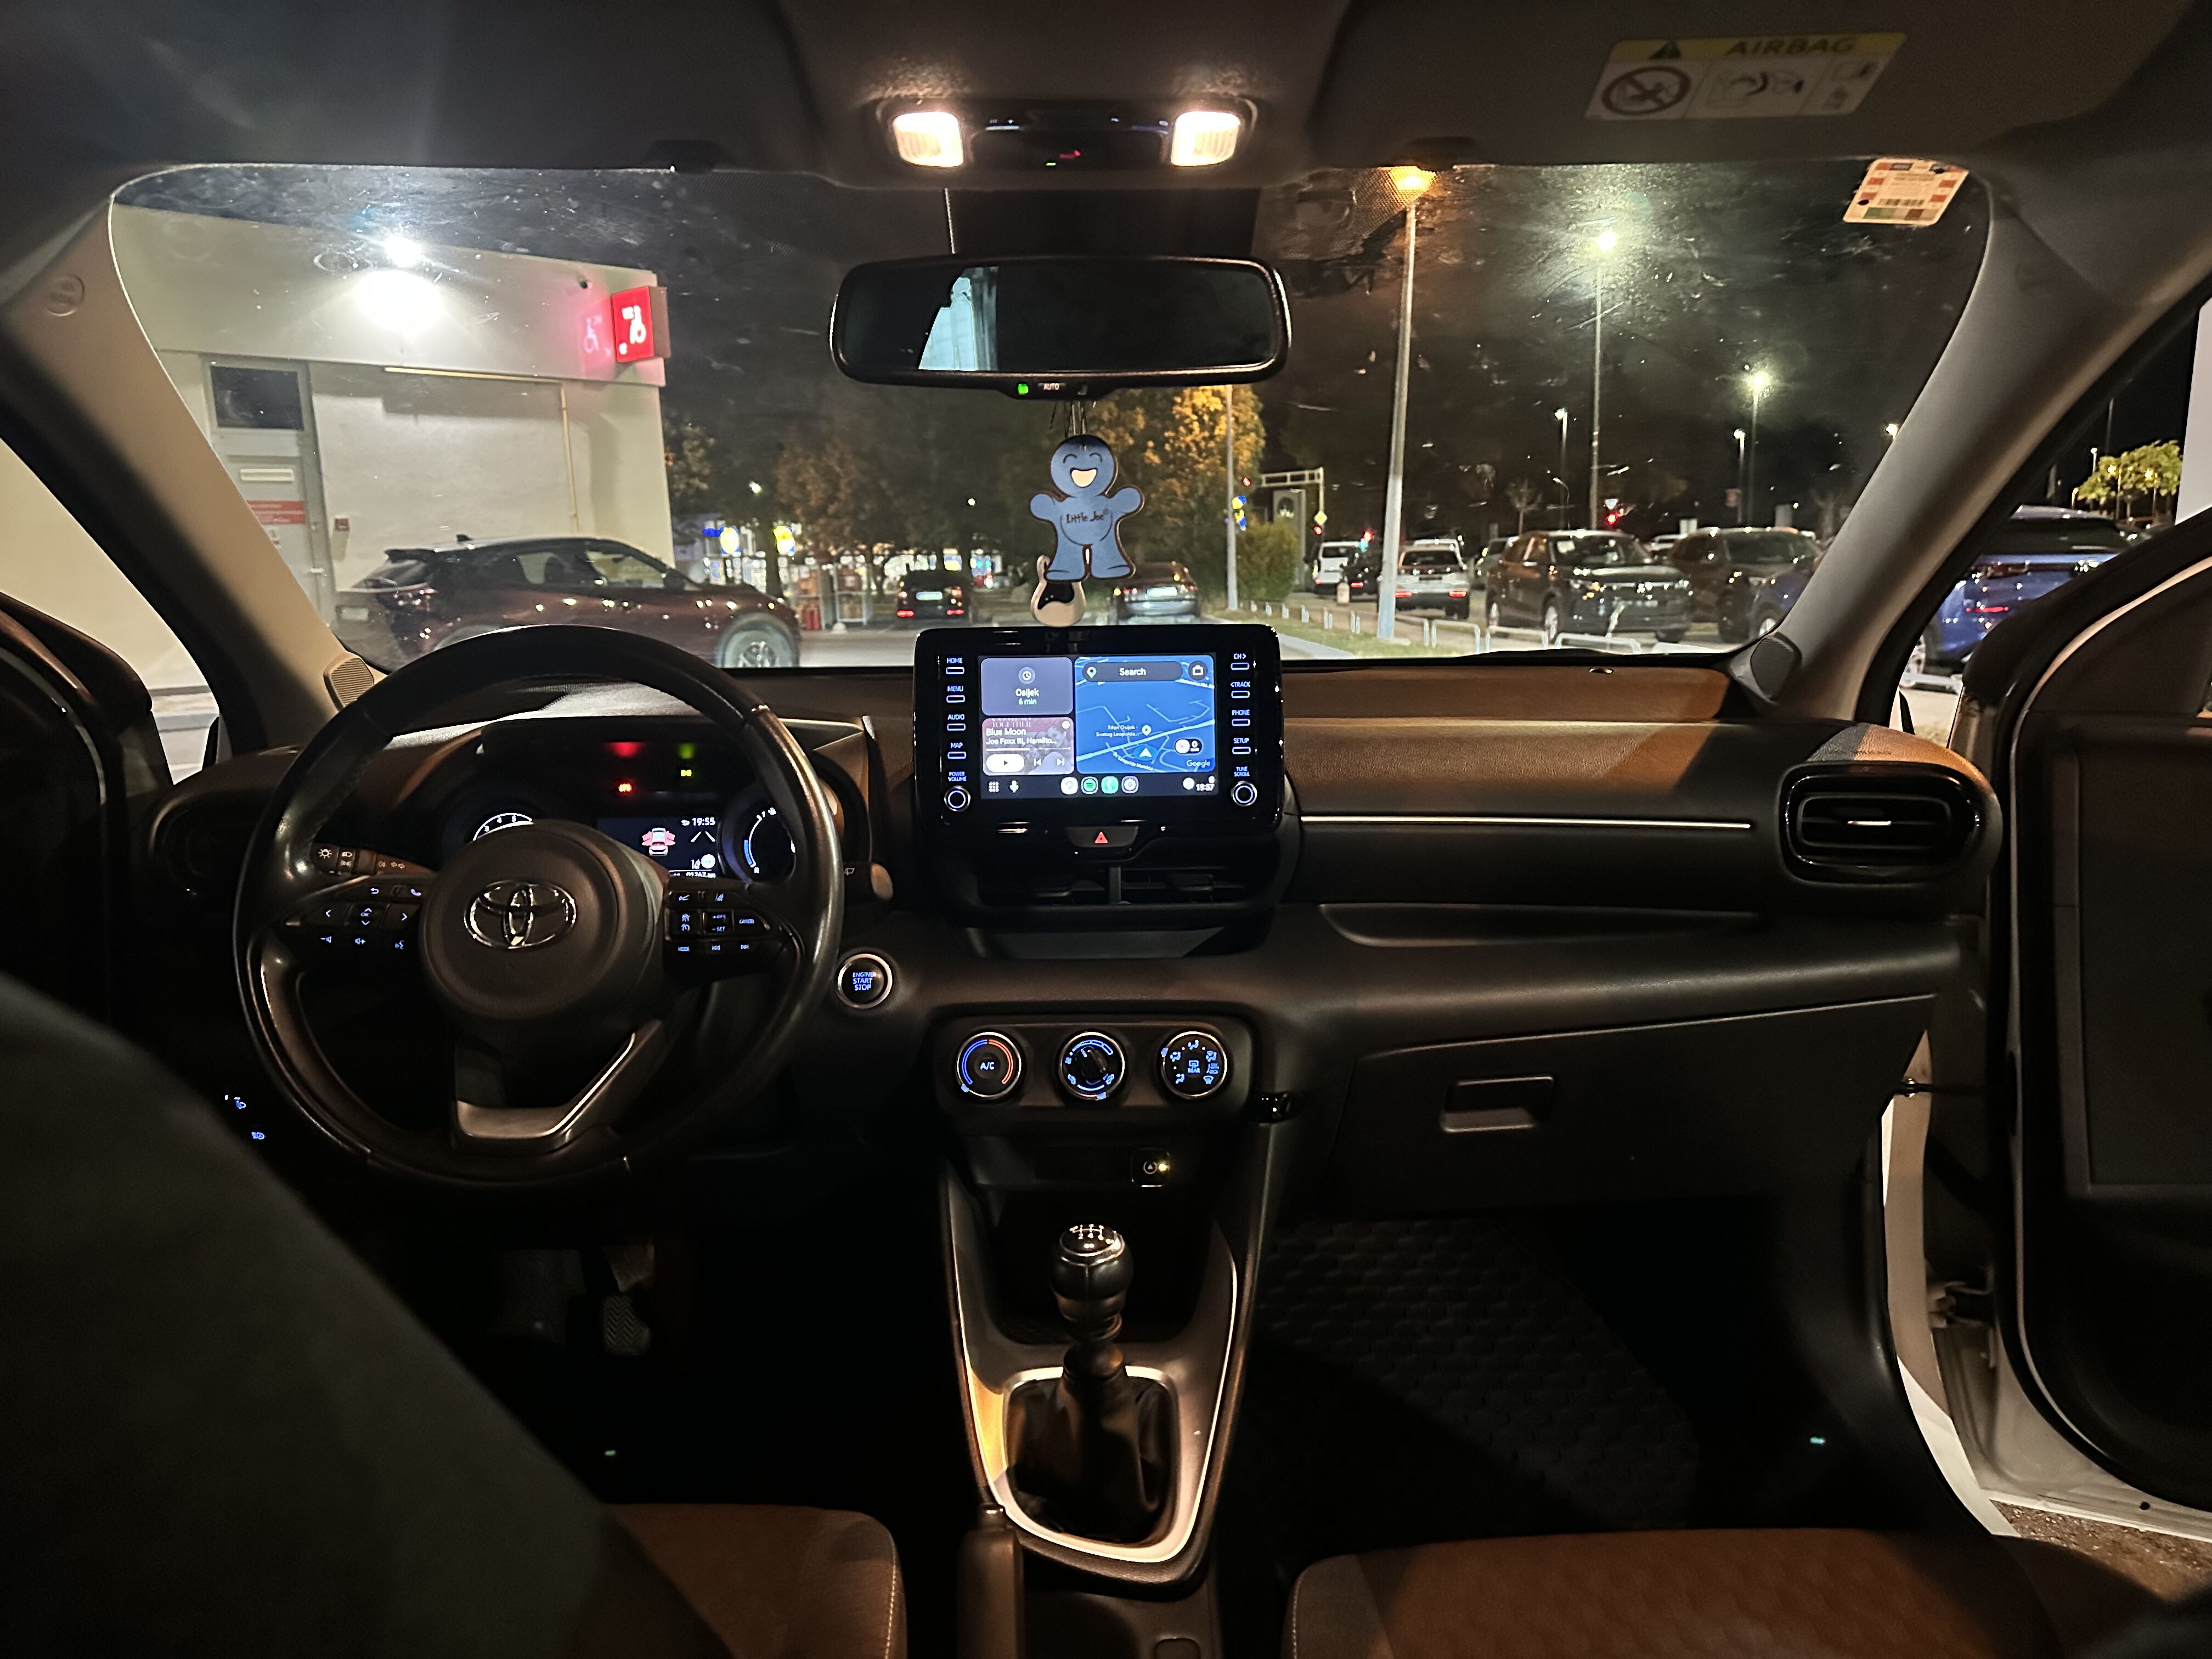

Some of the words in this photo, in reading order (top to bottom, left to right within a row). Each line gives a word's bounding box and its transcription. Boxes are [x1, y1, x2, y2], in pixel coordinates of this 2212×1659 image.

[1724, 36, 1855, 55] AIRBAG
[1066, 514, 1087, 524] Little
[1119, 667, 1147, 676] Search
[1015, 688, 1040, 698] Osijek
[986, 727, 1003, 736] Blue
[1005, 727, 1026, 736] Moon
[1186, 759, 1211, 768] Google
[692, 817, 715, 826] 19:55
[980, 1062, 995, 1070] A/C
